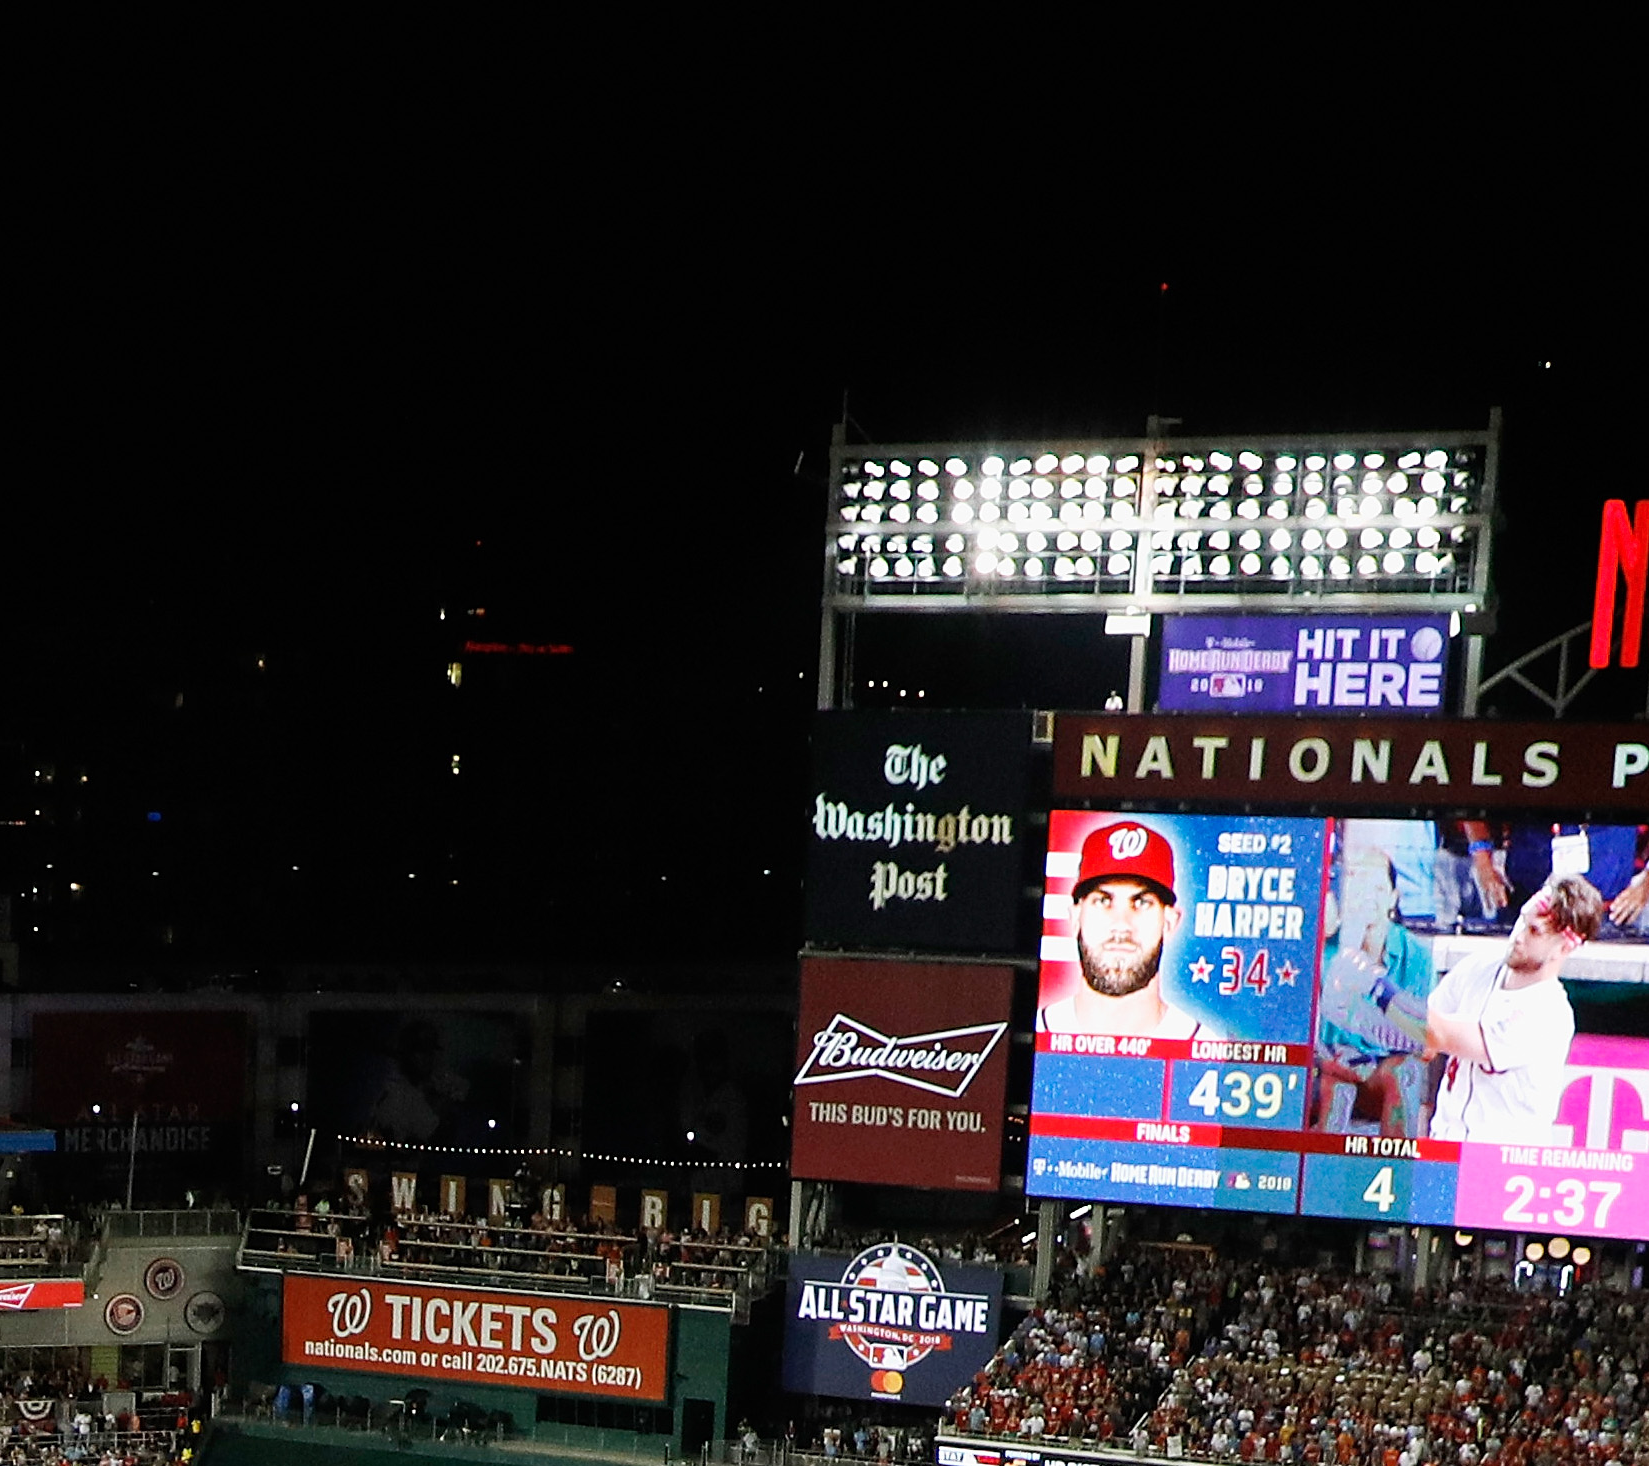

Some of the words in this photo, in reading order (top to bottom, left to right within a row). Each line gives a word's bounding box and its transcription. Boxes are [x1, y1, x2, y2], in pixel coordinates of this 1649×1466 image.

[1296, 628, 1361, 660] HIT
[1369, 628, 1407, 660] IT
[1293, 661, 1443, 707] HERE
[884, 743, 947, 789] The
[1079, 733, 1561, 789] NATIONALS
[813, 792, 1014, 853] Washington
[1217, 831, 1266, 855] SEED
[869, 860, 949, 911] Post
[1207, 865, 1295, 903] BRYCE
[1194, 902, 1303, 941] HARPER
[1219, 946, 1269, 997] 34
[812, 1026, 985, 1075] Budweiser
[1050, 1035, 1073, 1052] HR
[1075, 1036, 1115, 1054] OVER
[1191, 1042, 1261, 1062] LONGEST
[1263, 1045, 1287, 1063] HR
[808, 1101, 849, 1124] THIS
[851, 1103, 904, 1128] BUD'S
[907, 1107, 939, 1130] FOR
[941, 1111, 987, 1132] YOU.
[1188, 1069, 1298, 1119] 439'
[1136, 1123, 1191, 1144] FINALS
[1345, 1135, 1370, 1155] HR
[1372, 1137, 1421, 1159] TOTAL
[1498, 1145, 1537, 1168] TIME
[1540, 1148, 1635, 1174] REMAINING
[1363, 1166, 1395, 1213] 4
[1503, 1175, 1623, 1231] 2:37
[384, 1294, 558, 1355] TICKETS
[797, 1285, 845, 1320] ALL
[847, 1289, 914, 1326] STAR
[918, 1295, 990, 1334] GAME
[304, 1338, 417, 1366] nationals.com
[420, 1353, 438, 1368] or
[441, 1352, 473, 1371] call
[475, 1353, 588, 1383] 202.675.NATS
[590, 1362, 643, 1391] (6287)
